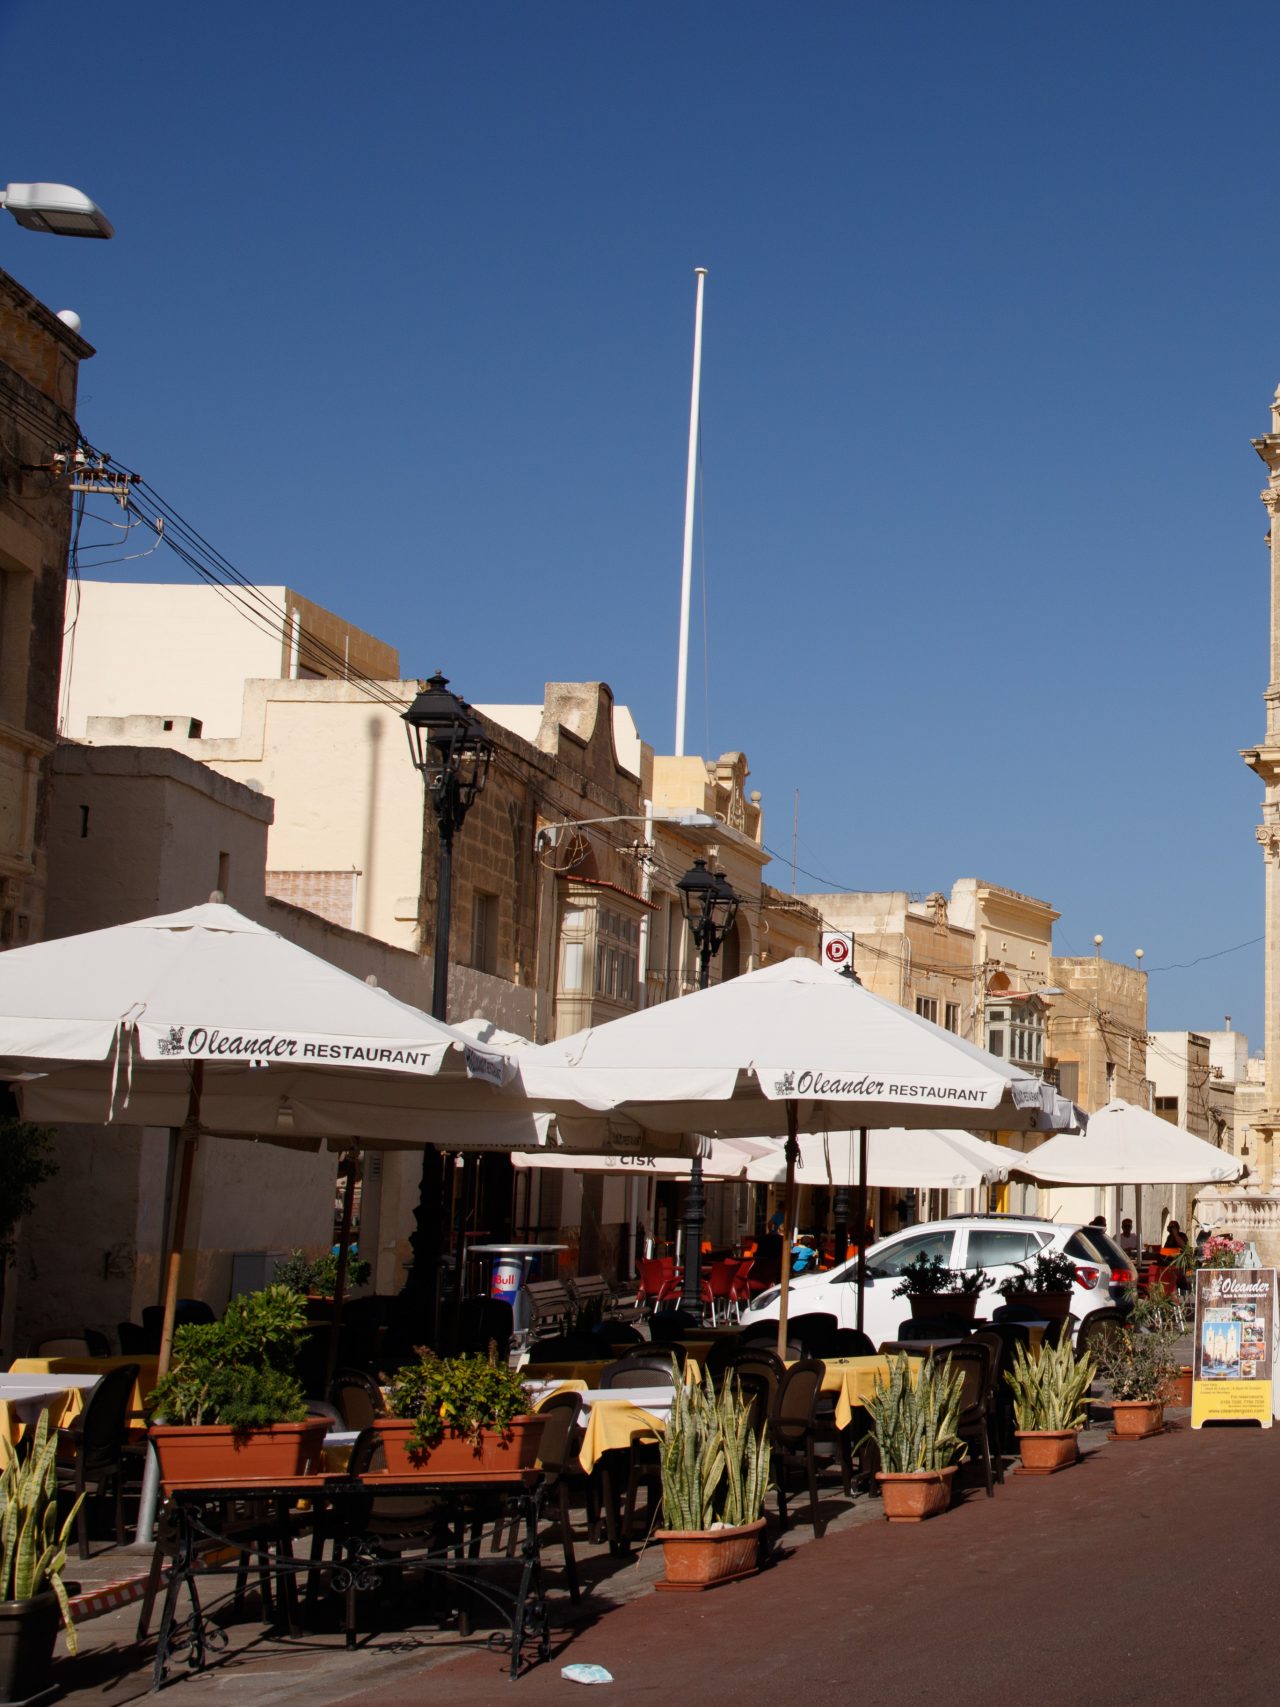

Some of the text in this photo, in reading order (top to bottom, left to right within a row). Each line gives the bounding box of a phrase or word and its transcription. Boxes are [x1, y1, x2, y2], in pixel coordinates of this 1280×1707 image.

[188, 1028, 431, 1066] Oleander RESTAURANT
[797, 1070, 988, 1102] Oleander RESTAURANT
[620, 1155, 656, 1168] CISK
[495, 1274, 515, 1285] Bull
[1222, 1278, 1269, 1293] Oleander
